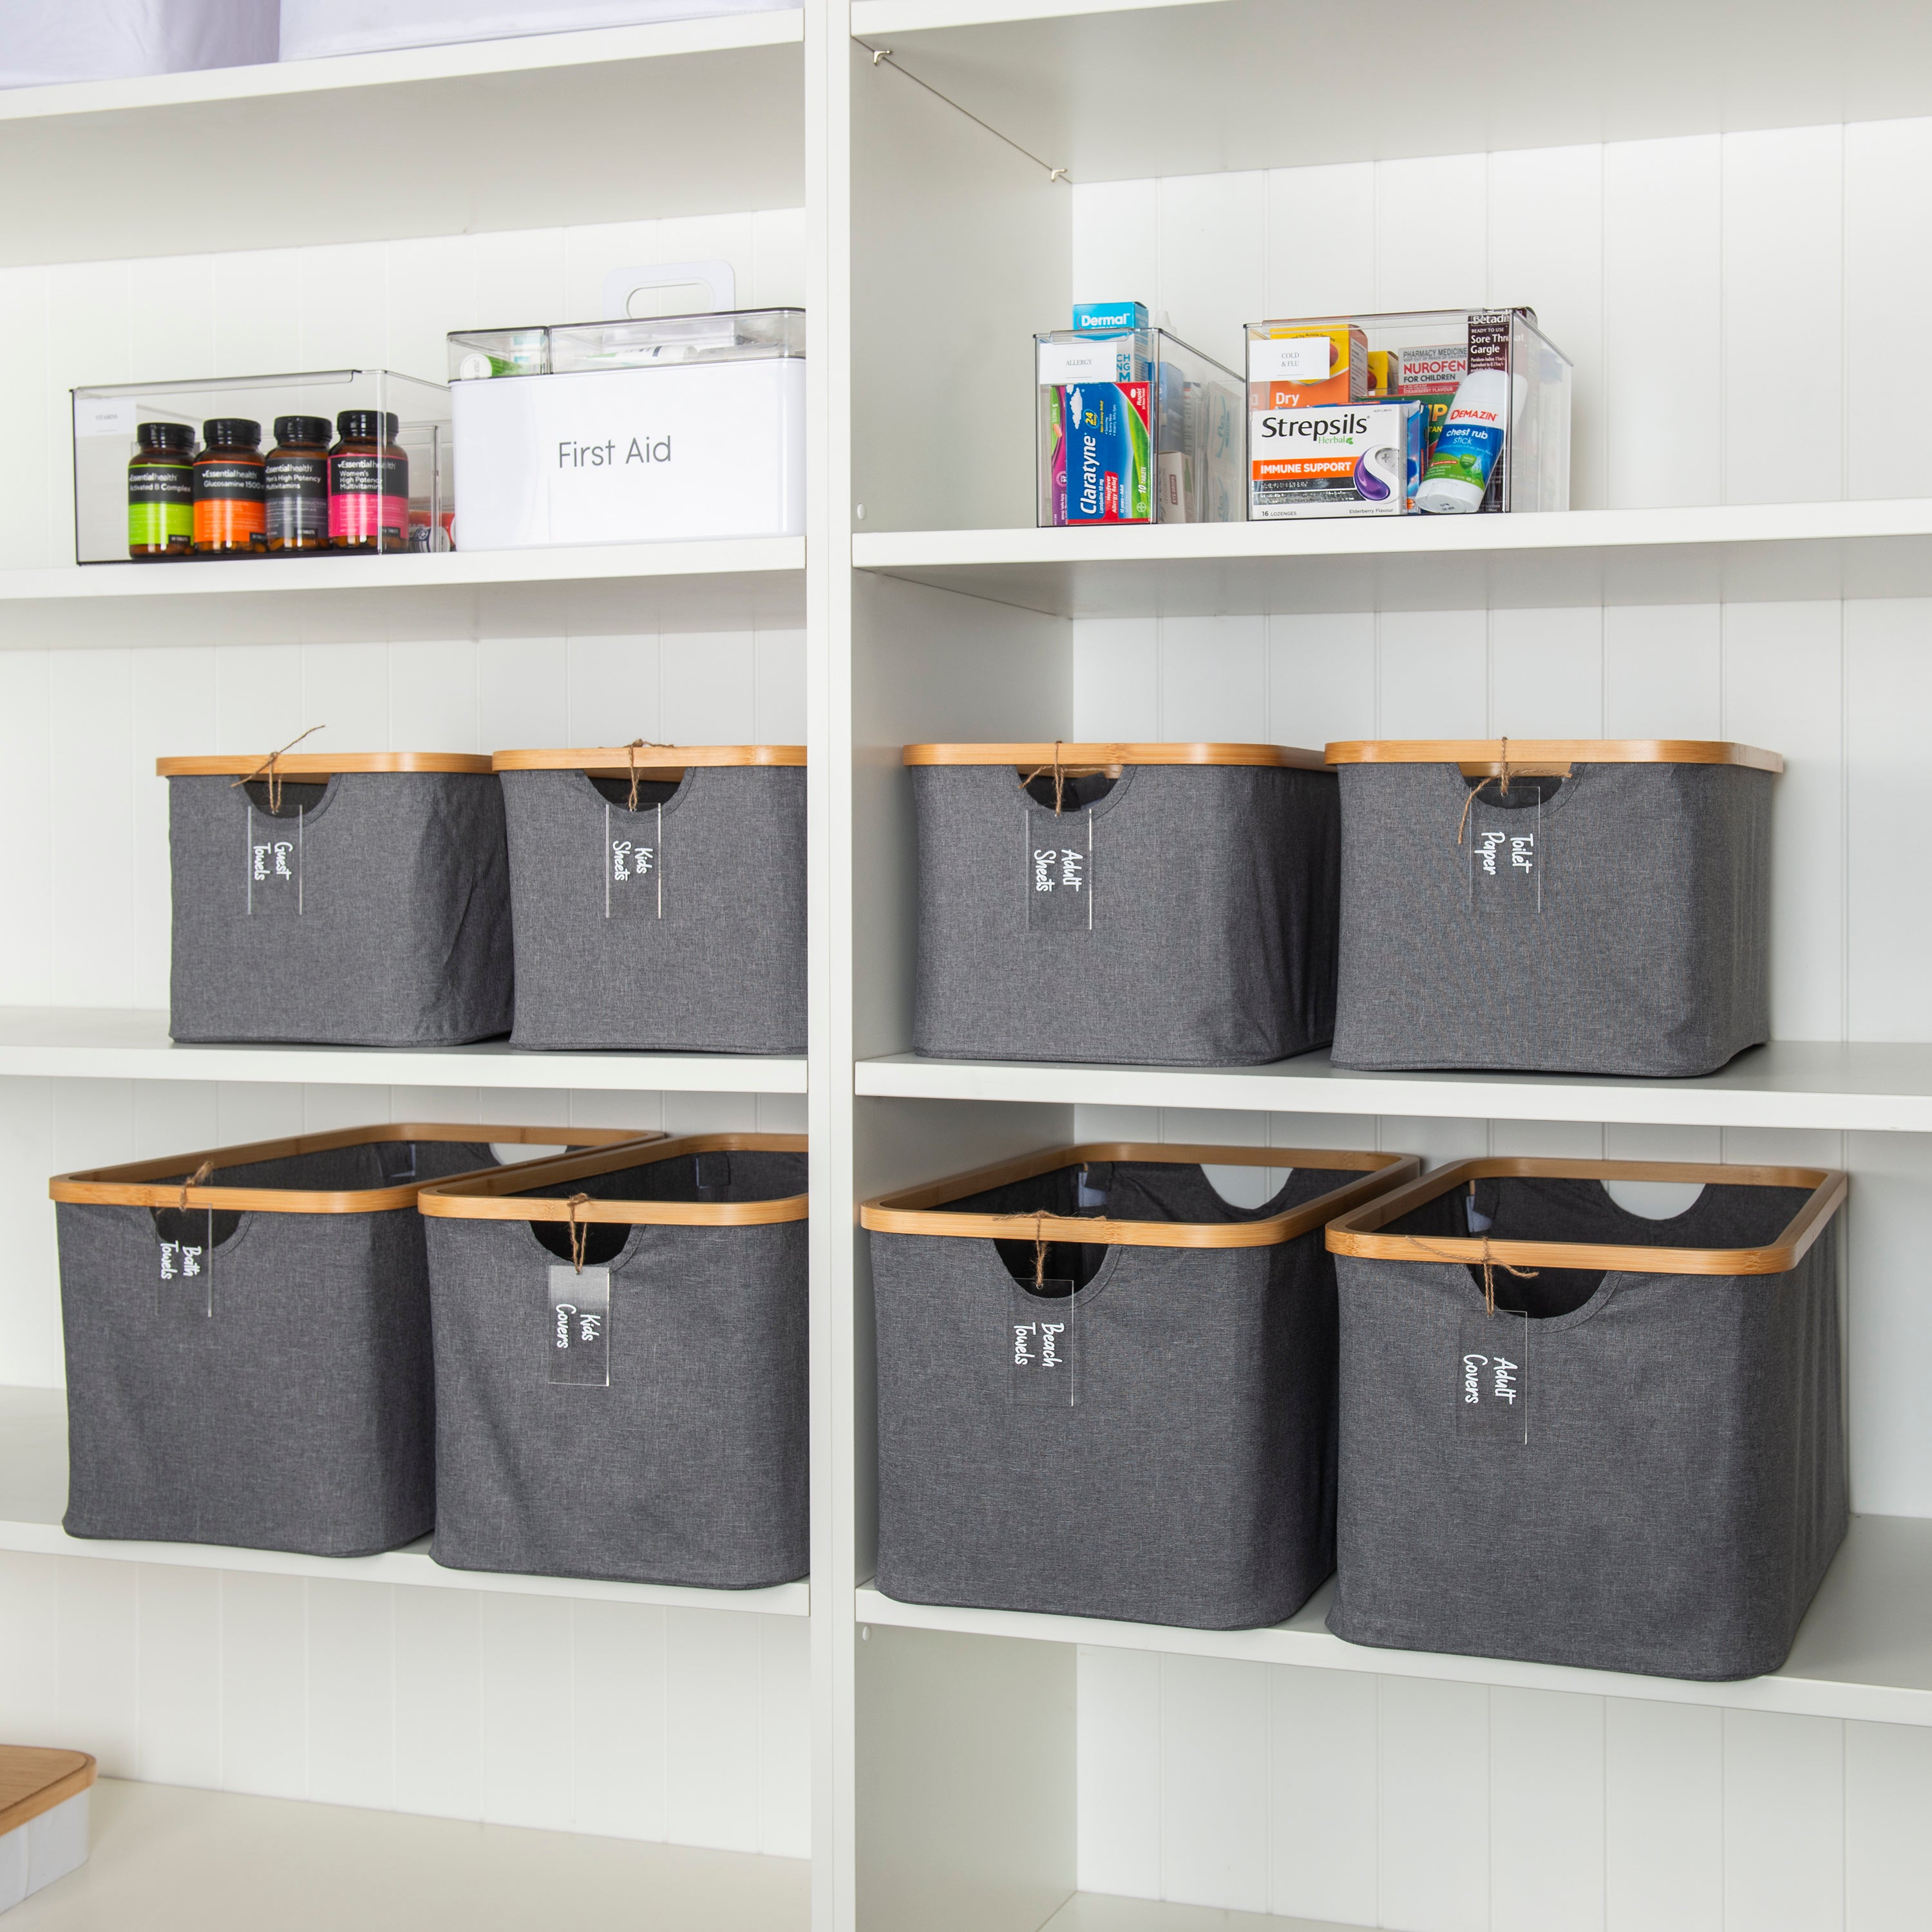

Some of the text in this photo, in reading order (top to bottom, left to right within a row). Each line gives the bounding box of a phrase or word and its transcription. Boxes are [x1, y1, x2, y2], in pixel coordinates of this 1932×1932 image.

[1081, 313, 1127, 327] Dermal
[1403, 347, 1467, 357] PHARMACY MEDICINE
[1470, 335, 1491, 343] Sore
[1470, 345, 1500, 355] Gargle
[1403, 360, 1466, 375] NUROFEN
[1403, 374, 1456, 383] FOR CHILDREN
[1276, 392, 1300, 406] Dry
[1085, 412, 1093, 424] 24
[1262, 413, 1367, 442] Strepsils
[1450, 410, 1496, 422] DEMAZIN
[1318, 436, 1345, 444] Herbal
[1446, 428, 1488, 439] chest rub
[1453, 436, 1473, 444] stick
[559, 435, 671, 468] First Aid
[278, 475, 293, 483] High
[293, 474, 321, 484] Potency
[1080, 435, 1100, 515] Claratyne
[1260, 462, 1352, 475] IMMUNE SUPPORT
[160, 482, 191, 493] Complex
[204, 480, 245, 488] Glucosamine
[1137, 484, 1147, 493] 10
[253, 842, 271, 881] Towels
[274, 842, 294, 881] Guest
[612, 840, 632, 882] Sheets
[634, 848, 654, 874] Kids
[1473, 831, 1506, 875] Paper
[1510, 833, 1534, 874] Toilet
[1034, 849, 1057, 892] Sheets
[1061, 849, 1083, 892] Adult
[160, 1240, 180, 1280] Towels
[182, 1245, 202, 1276] Bath
[555, 1303, 577, 1349] Covers
[580, 1314, 601, 1341] Kids
[1013, 1321, 1036, 1365] Towels
[1041, 1322, 1065, 1367] Beach
[1463, 1354, 1488, 1404] Covers
[1493, 1357, 1518, 1405] Adult
